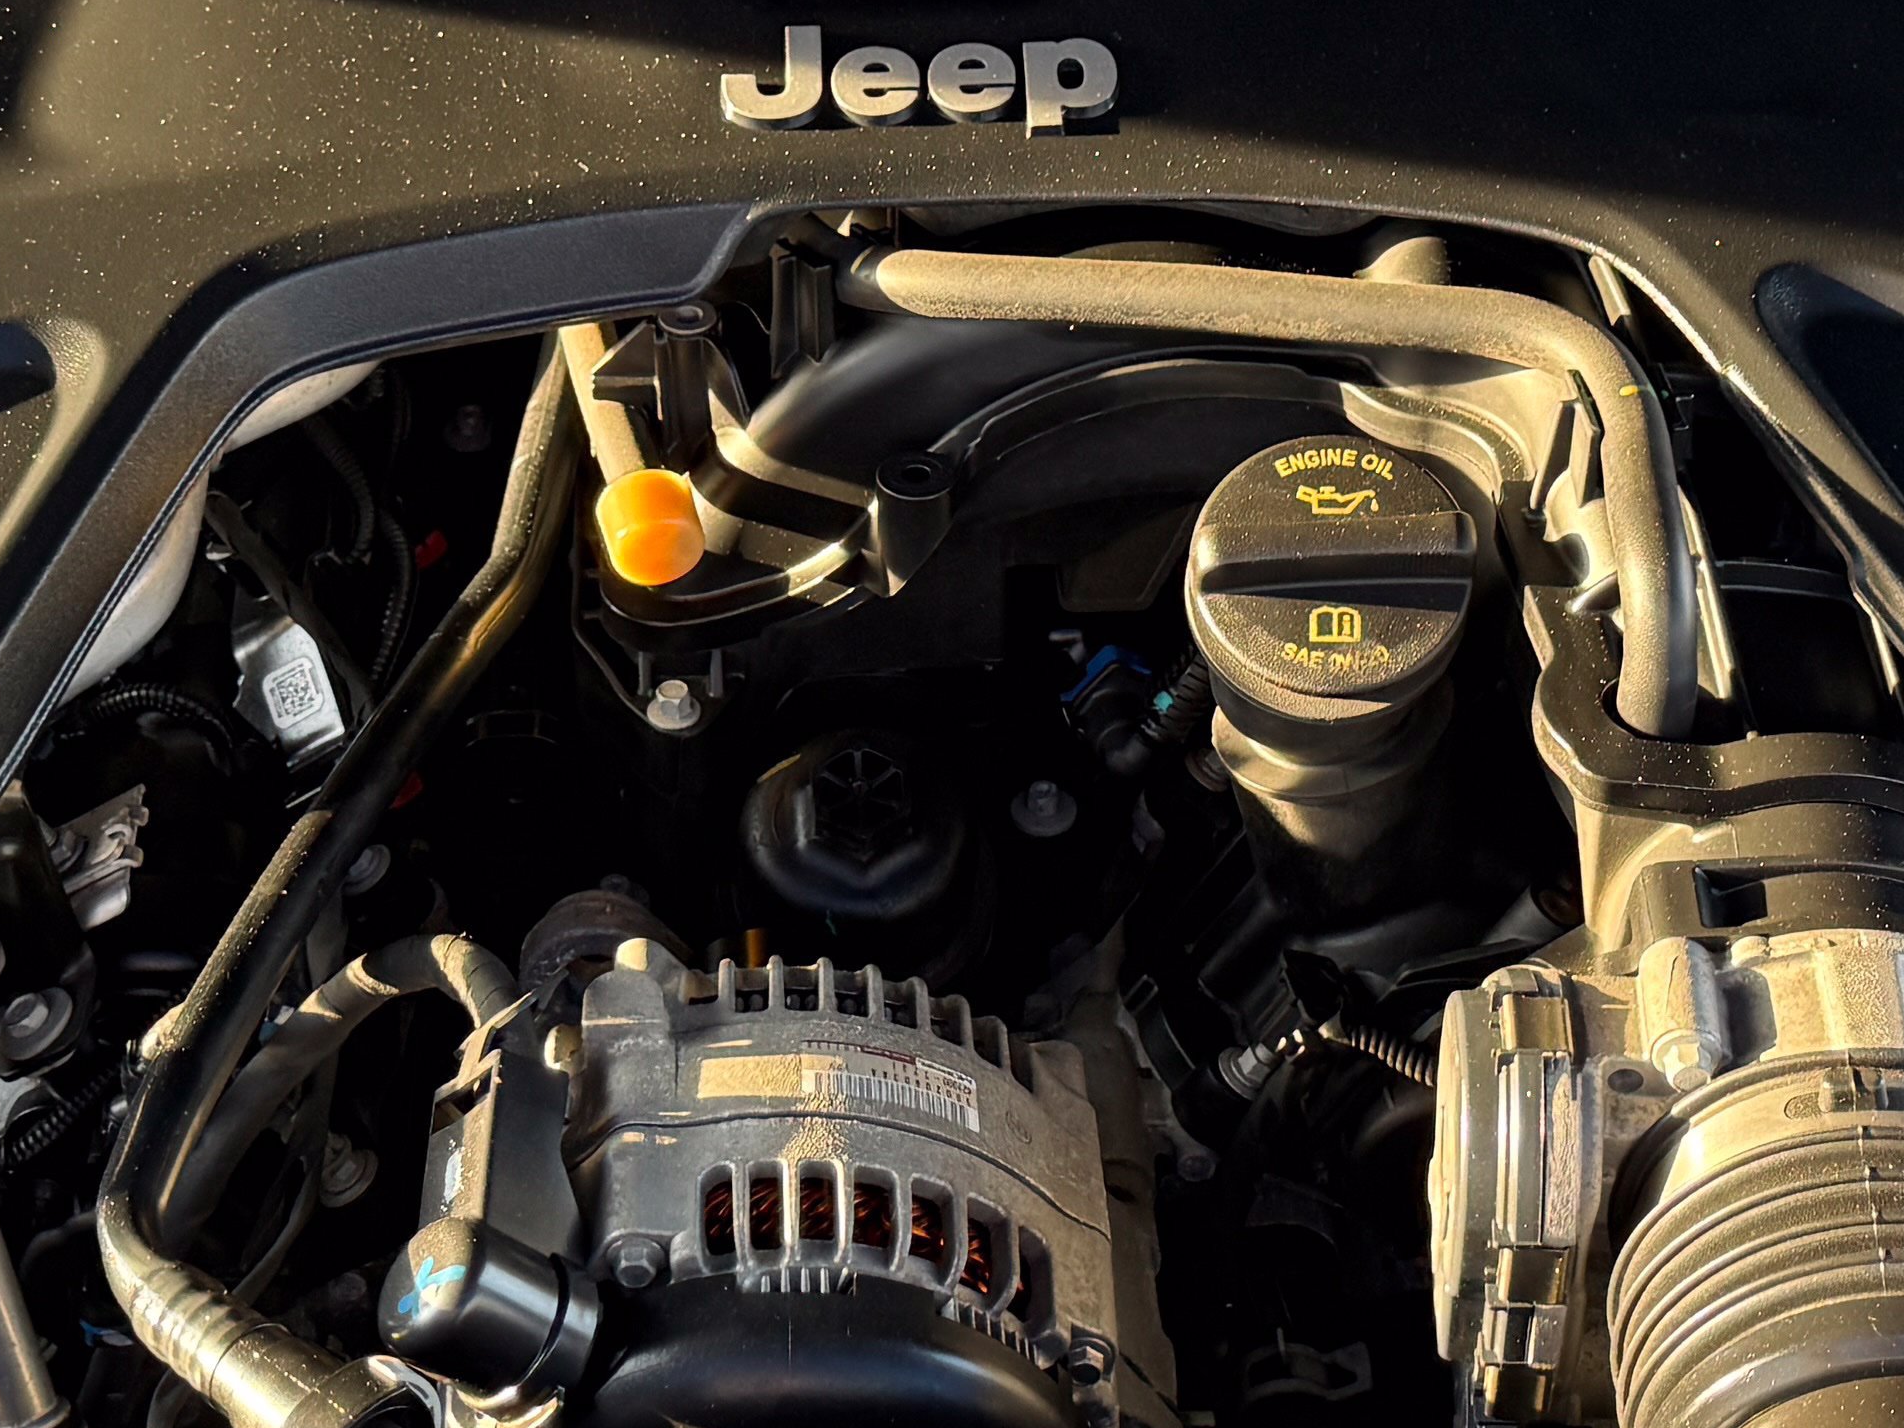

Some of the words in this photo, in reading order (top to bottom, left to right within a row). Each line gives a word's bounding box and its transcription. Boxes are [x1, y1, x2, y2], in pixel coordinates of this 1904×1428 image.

[720, 24, 1119, 139] Jeep
[1274, 447, 1358, 478] ENGINE
[1361, 453, 1394, 481] OIL
[1281, 642, 1325, 668] SAE
